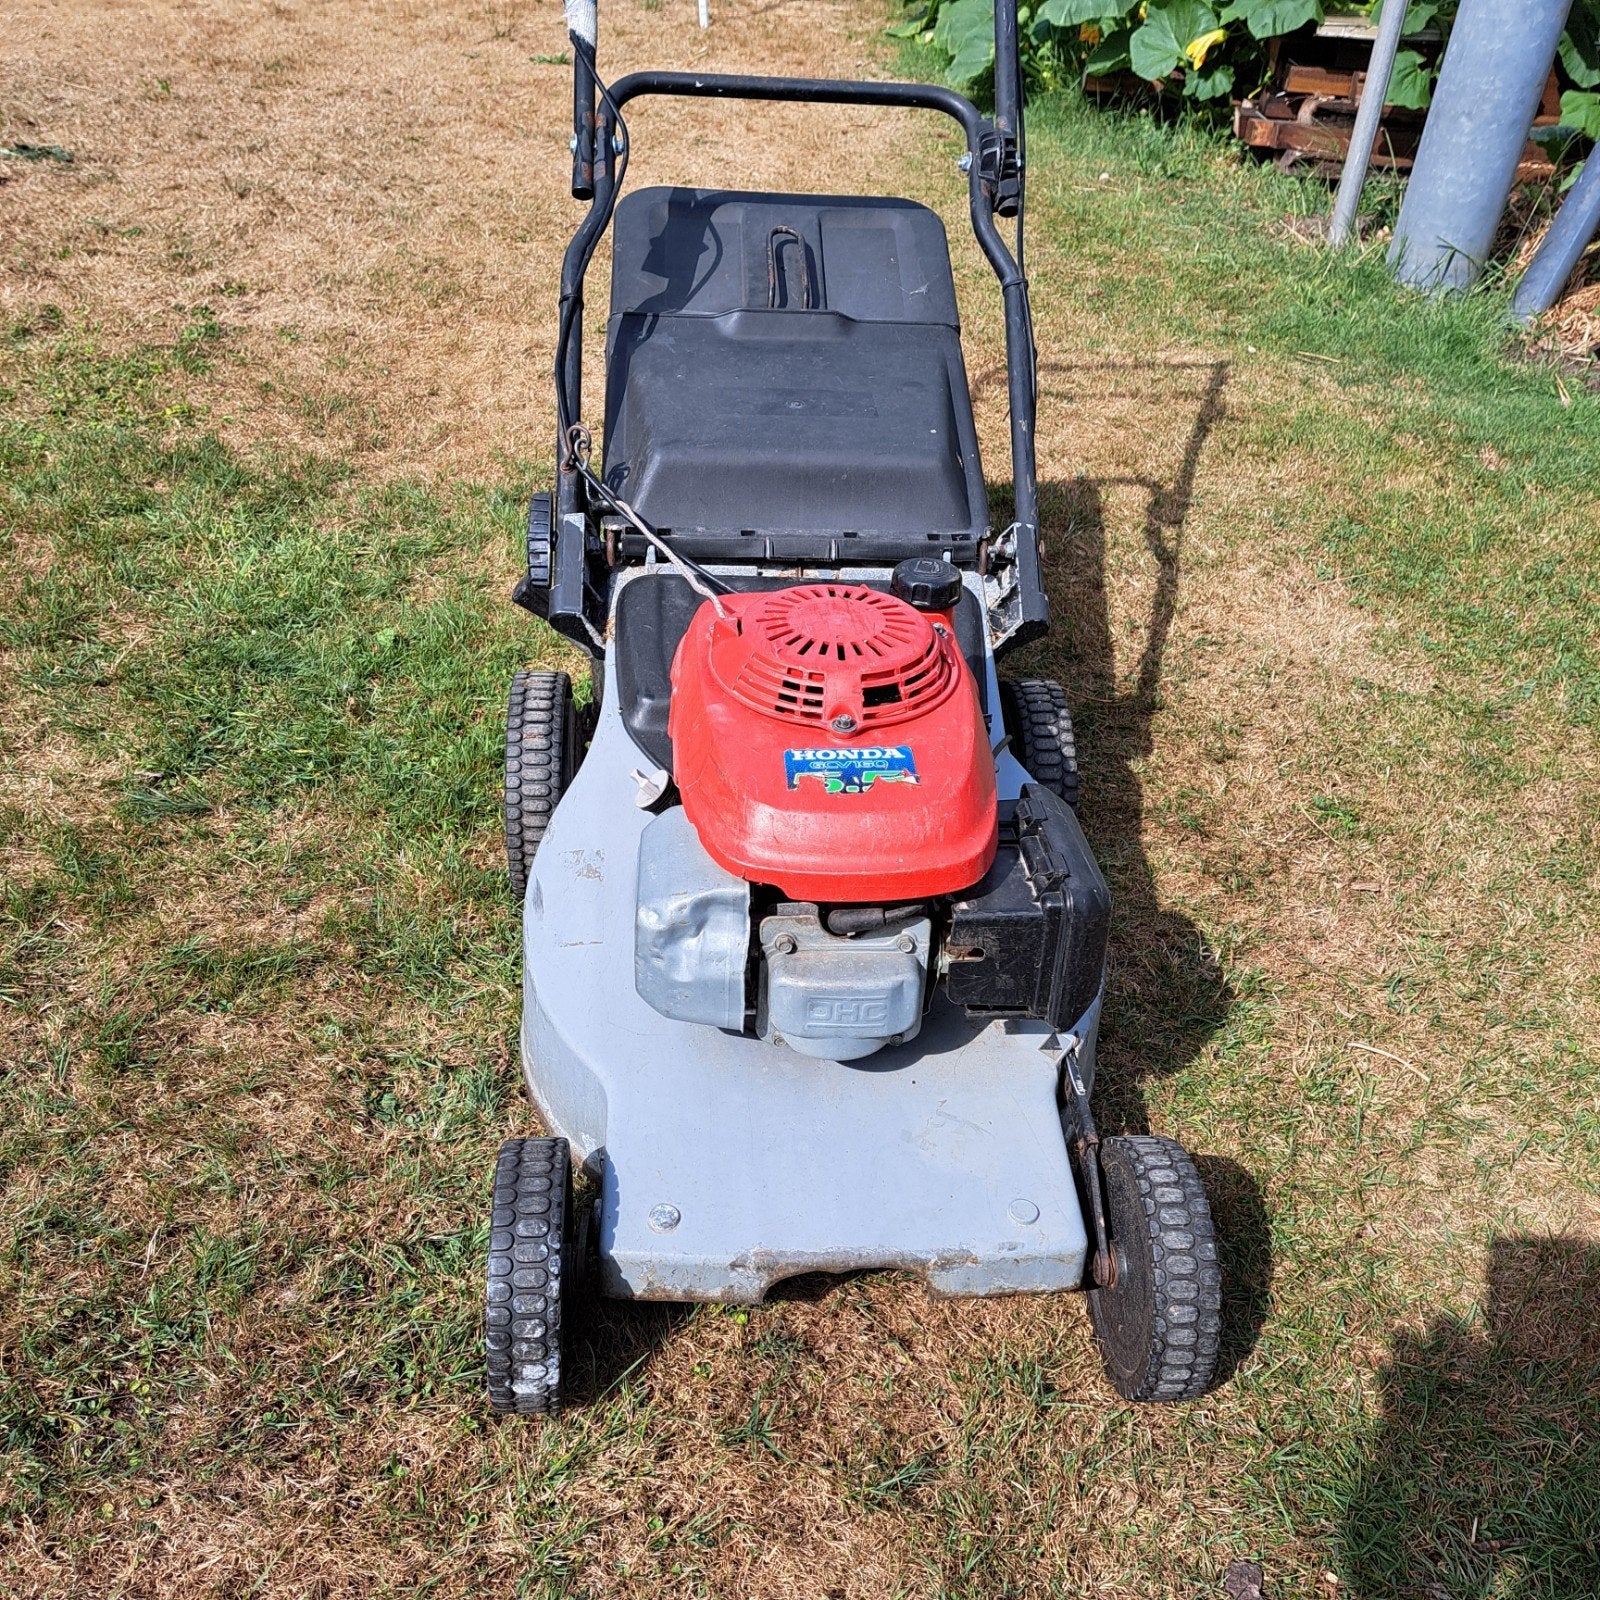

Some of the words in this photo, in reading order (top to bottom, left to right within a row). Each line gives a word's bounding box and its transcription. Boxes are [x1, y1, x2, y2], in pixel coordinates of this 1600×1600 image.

[791, 748, 906, 761] HONDA
[809, 760, 889, 769] GCV160
[807, 1001, 888, 1021] OHC
